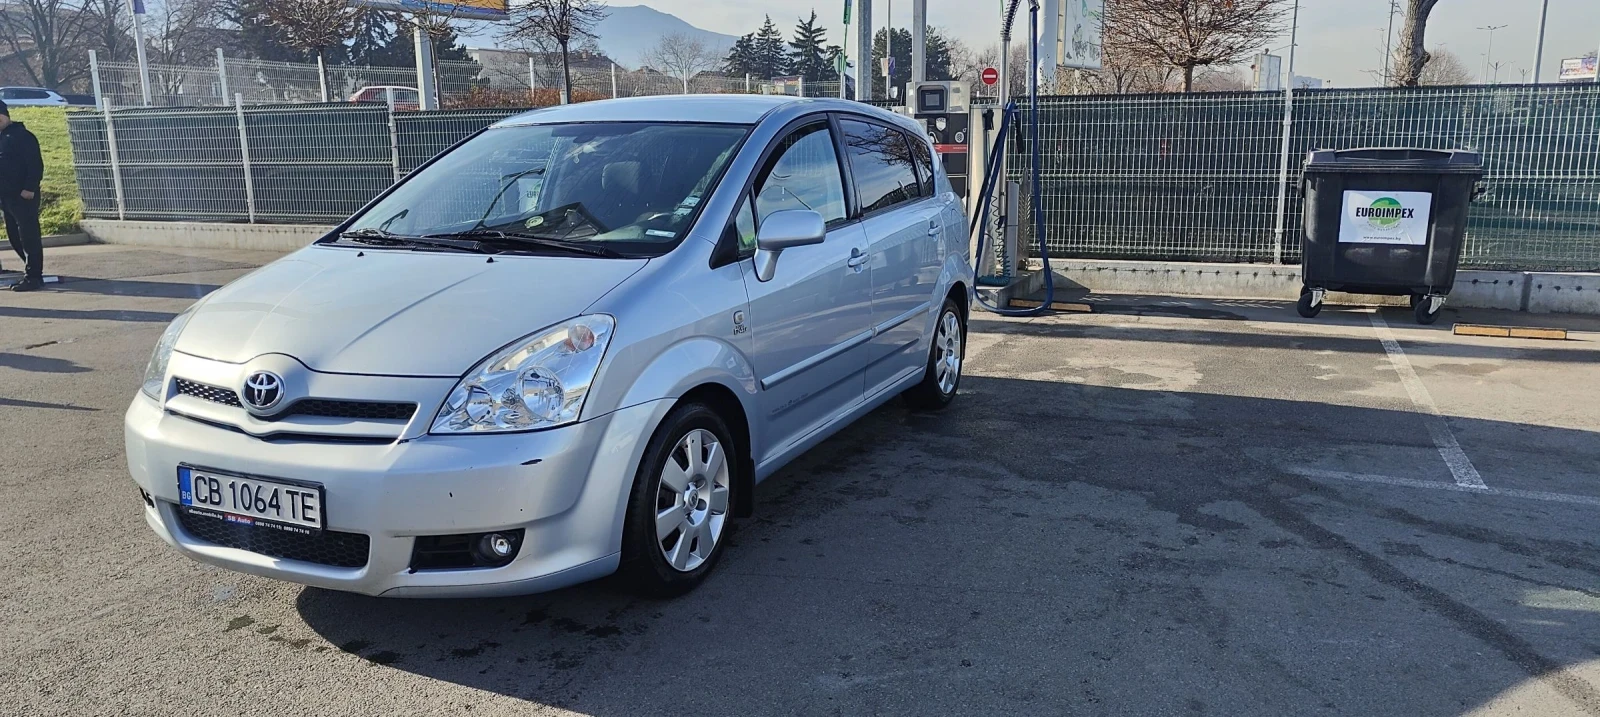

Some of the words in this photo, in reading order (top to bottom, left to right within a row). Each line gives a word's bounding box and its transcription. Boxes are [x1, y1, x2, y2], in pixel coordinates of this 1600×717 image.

[1356, 207, 1414, 218] EUROIMPEX
[182, 490, 192, 500] BG
[194, 475, 222, 506] CB
[228, 481, 281, 517] 1064
[285, 489, 316, 523] TE
[237, 516, 251, 525] Auto
